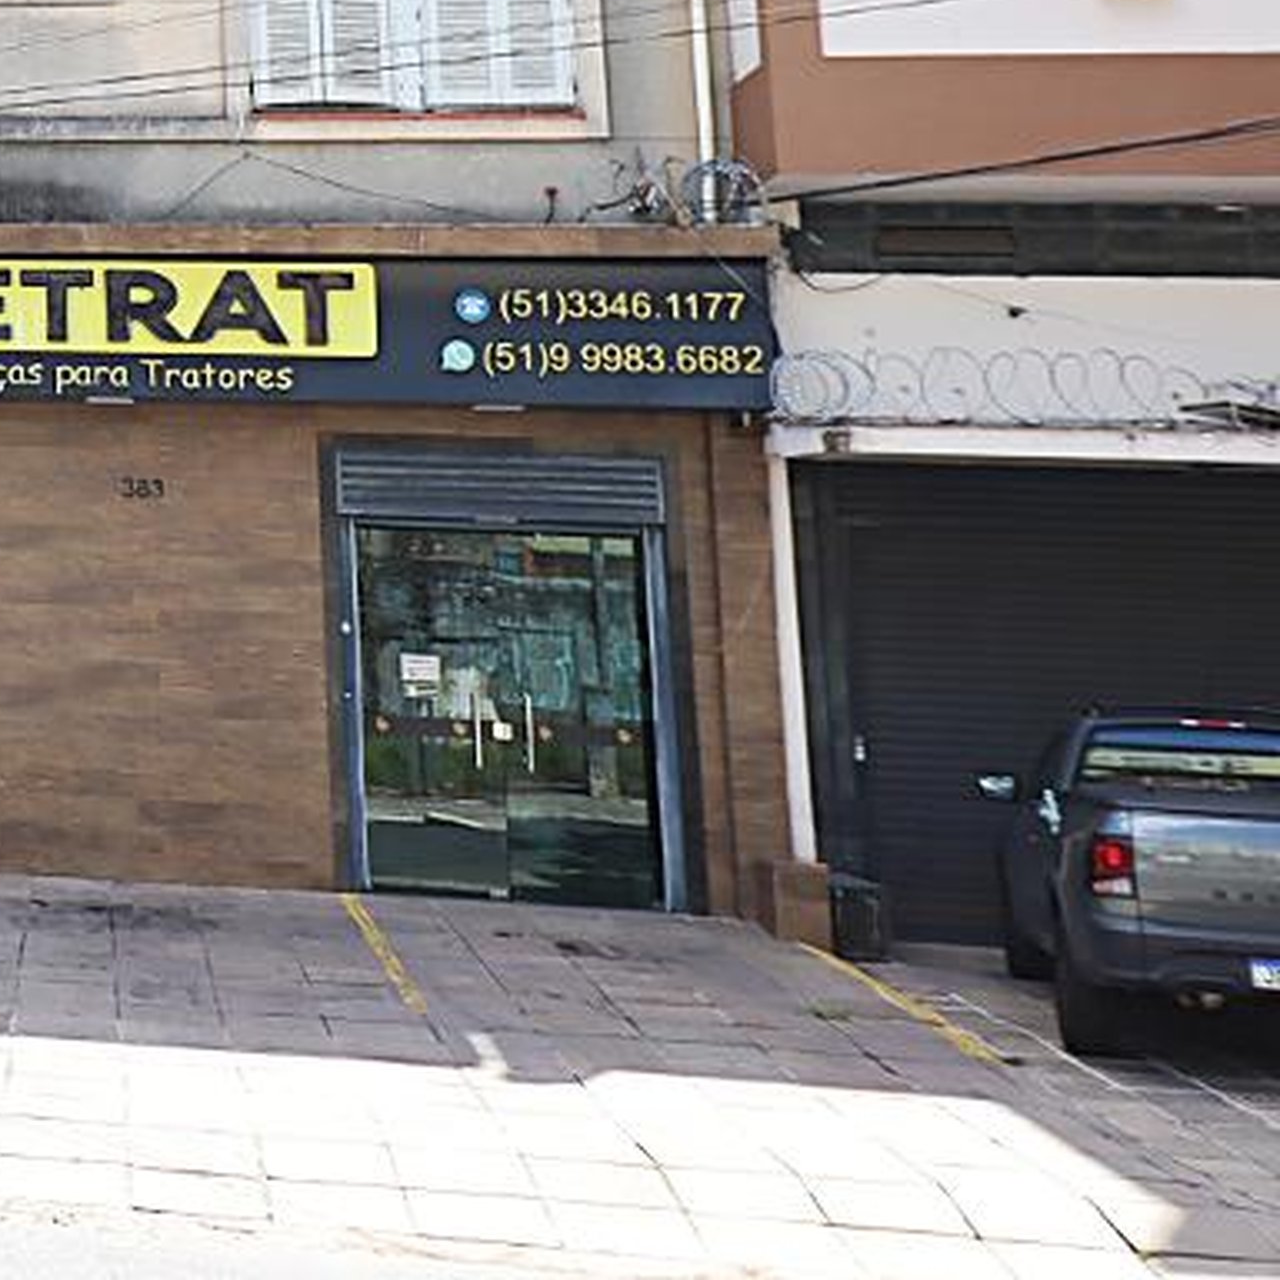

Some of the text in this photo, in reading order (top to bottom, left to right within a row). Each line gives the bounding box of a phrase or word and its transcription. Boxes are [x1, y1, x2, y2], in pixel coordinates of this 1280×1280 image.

[498, 289, 746, 324] (51)3346.1177
[55, 362, 130, 394] para
[140, 358, 295, 391] Tratores
[482, 342, 765, 376] (51)9 9983.6682
[120, 476, 165, 499] 383
